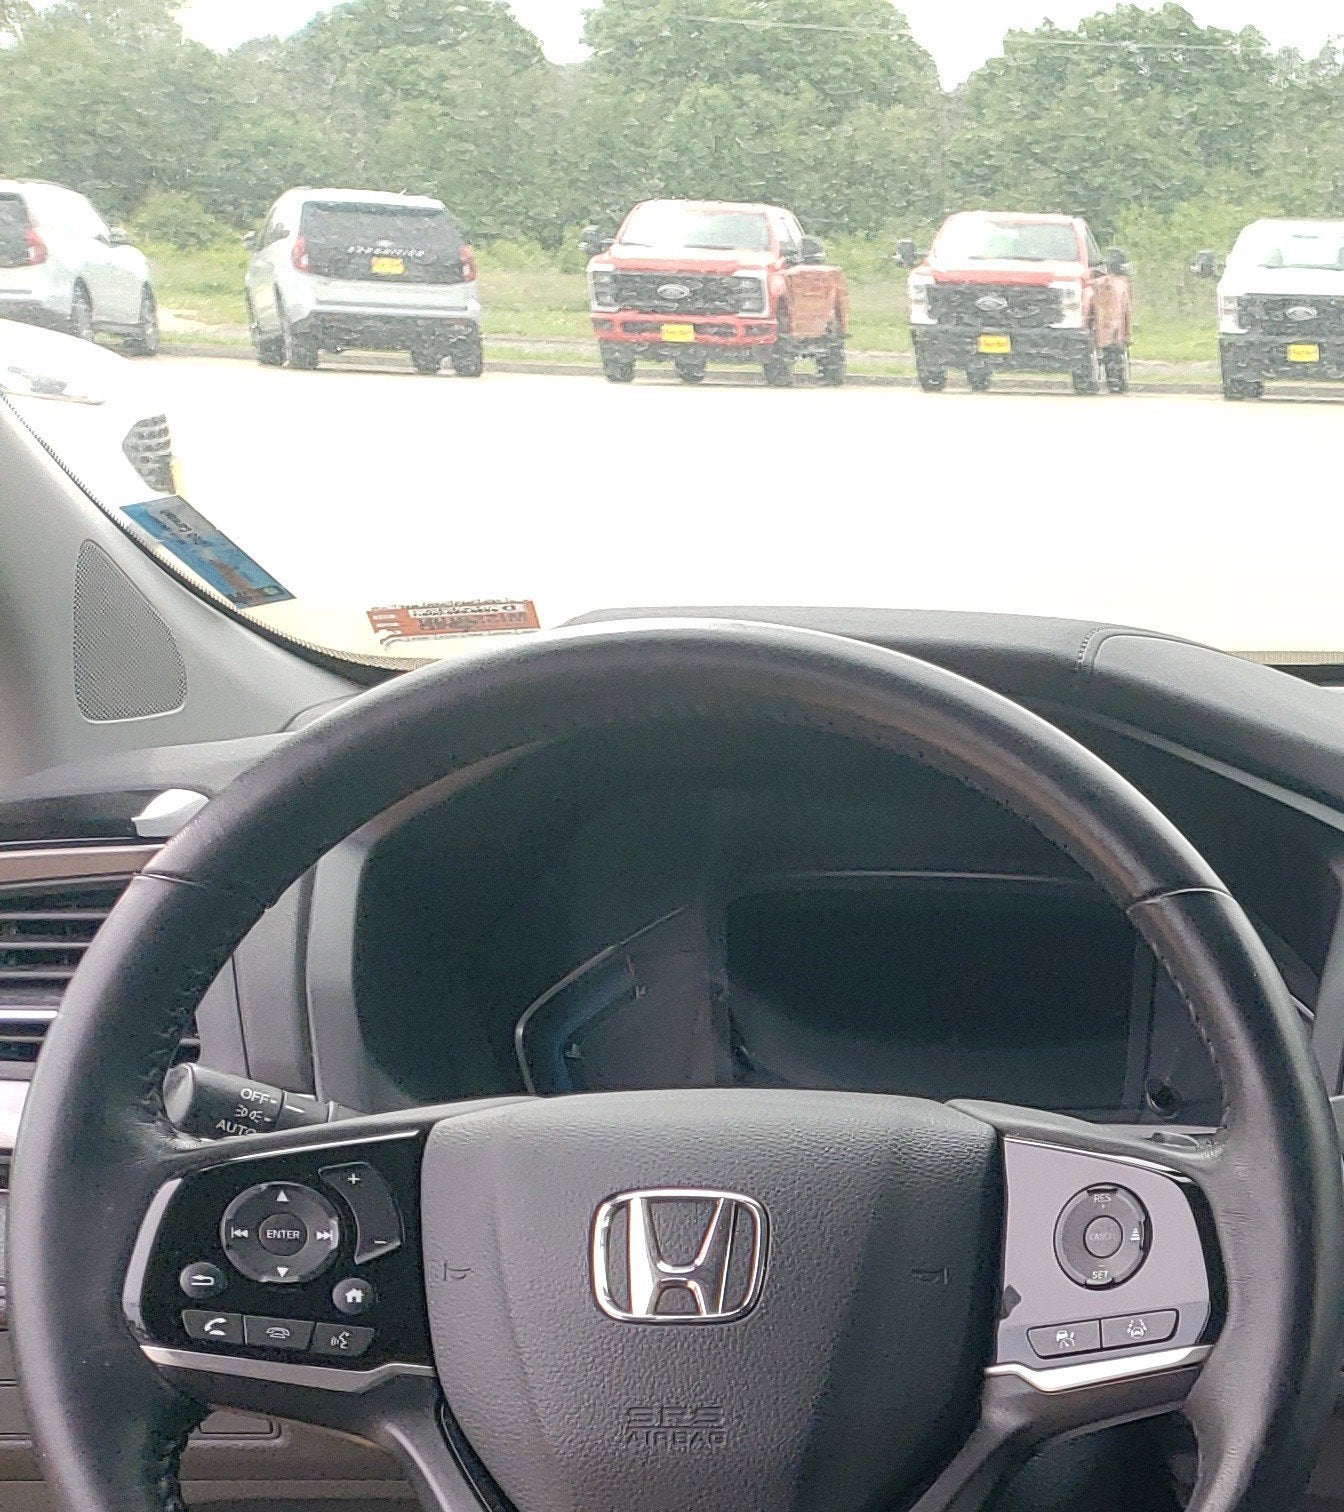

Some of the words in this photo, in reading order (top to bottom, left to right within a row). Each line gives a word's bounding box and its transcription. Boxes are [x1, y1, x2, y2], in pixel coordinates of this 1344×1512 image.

[240, 1088, 270, 1104] OFF
[266, 1229, 300, 1239] ENTER
[1092, 1270, 1109, 1279] SET
